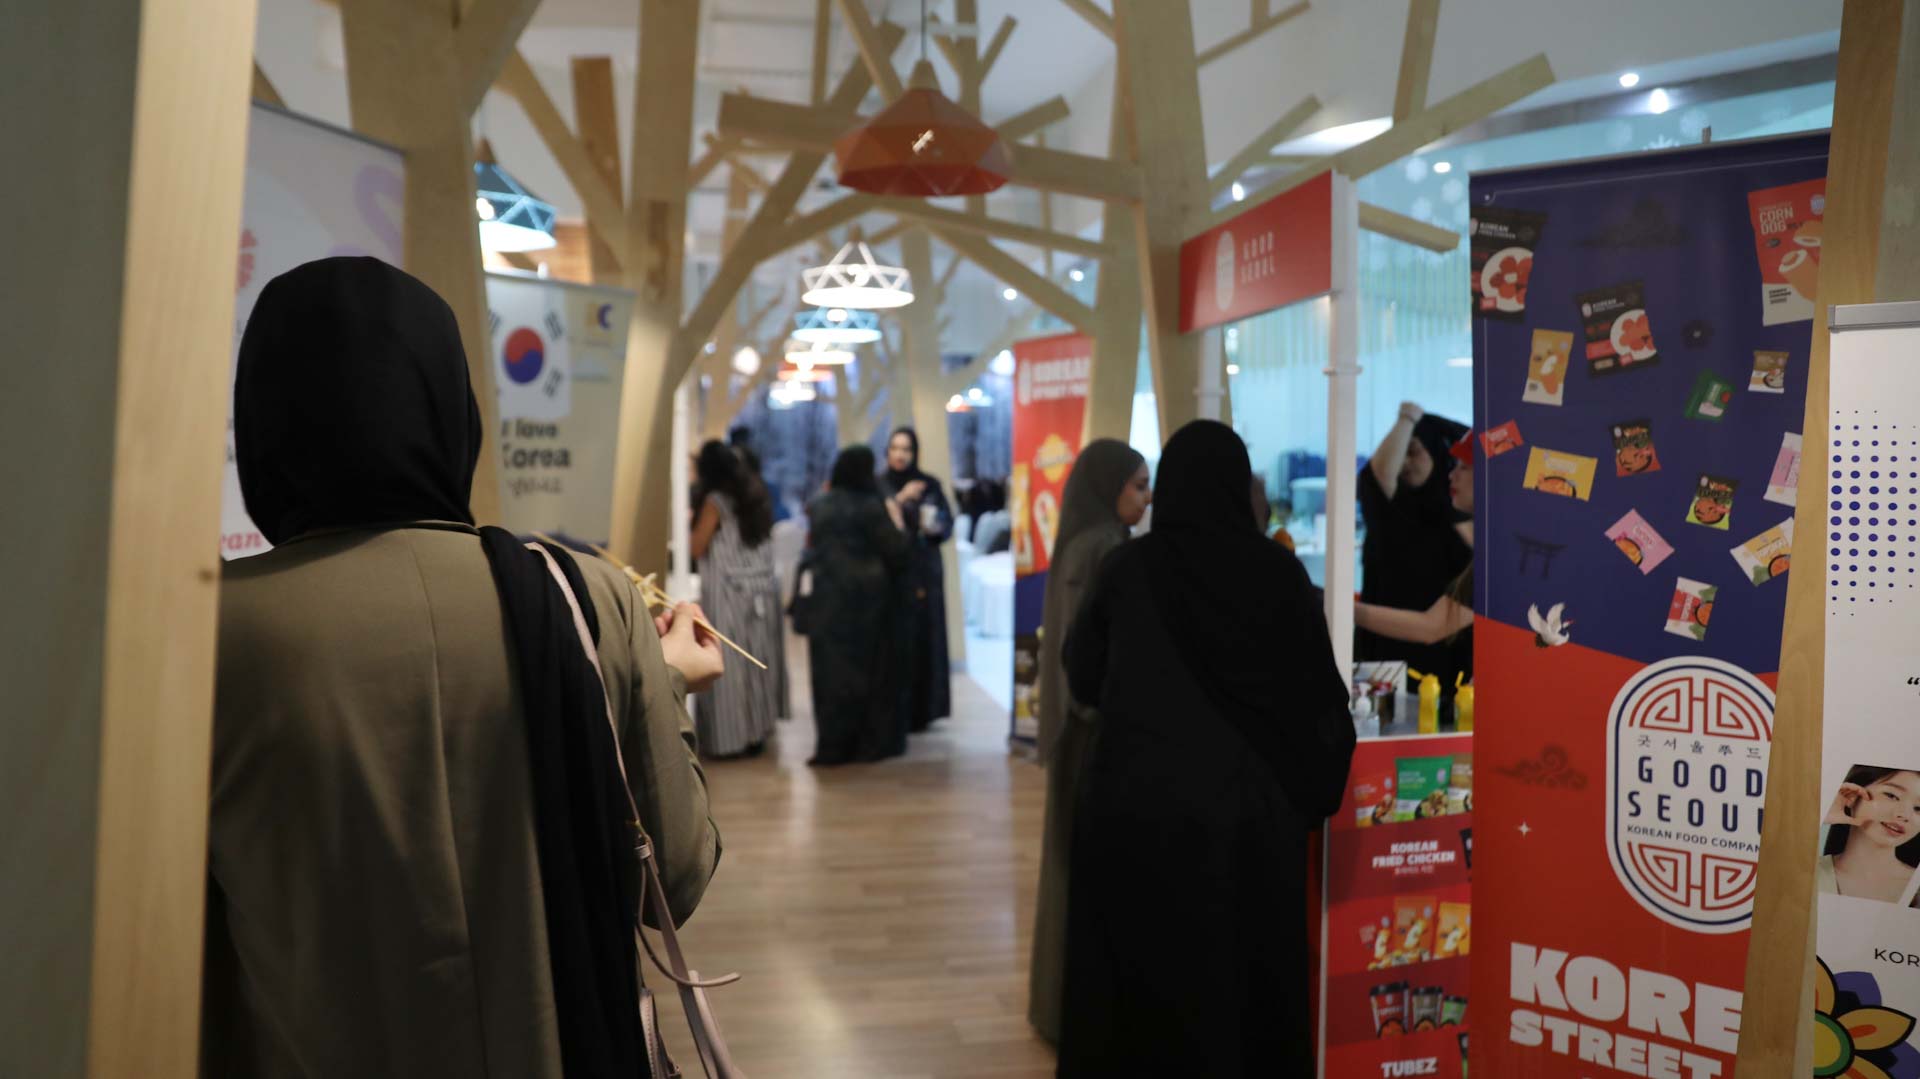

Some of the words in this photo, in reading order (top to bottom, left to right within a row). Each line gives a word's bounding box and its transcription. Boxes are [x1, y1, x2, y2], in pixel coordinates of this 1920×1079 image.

[1760, 207, 1794, 222] CORN
[1761, 220, 1787, 235] DOG
[1638, 756, 1763, 797] GOOD
[1626, 824, 1672, 840] KOREAN
[1675, 832, 1708, 845] FOOD
[1391, 840, 1438, 854] KOREAN
[1372, 855, 1404, 868] FRIED
[1407, 850, 1455, 865] CHICKEN
[1509, 1008, 1722, 1079] STREET
[1381, 1056, 1437, 1078] TUBEZ
